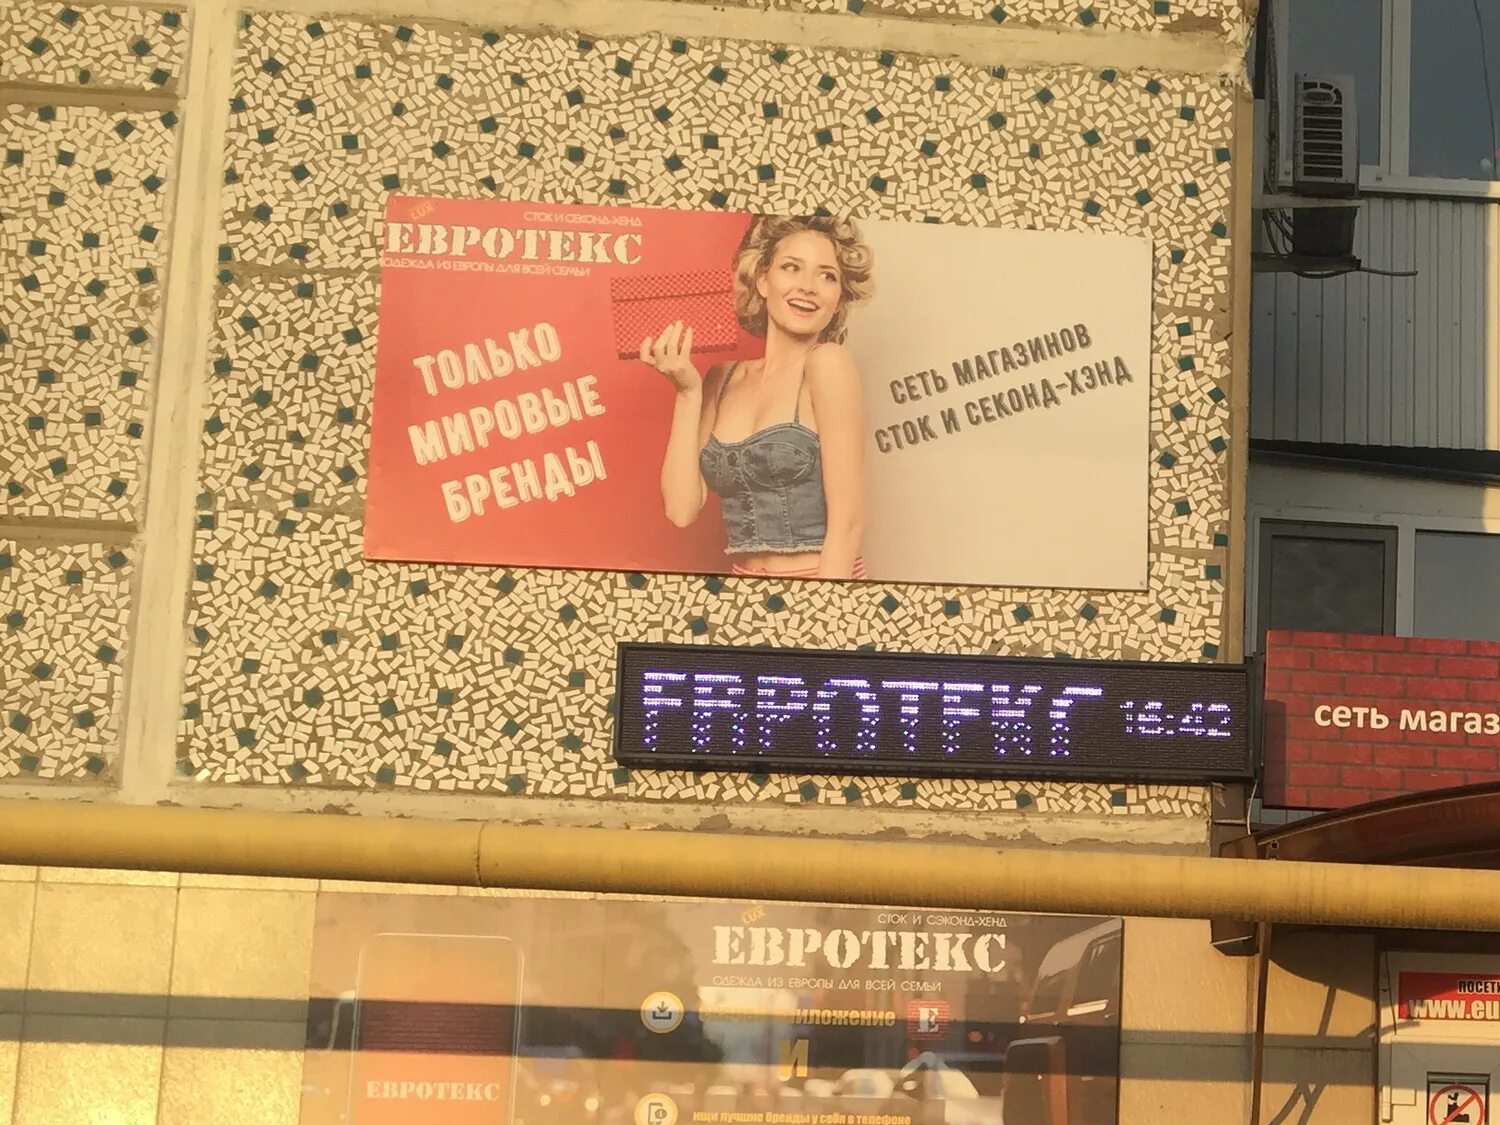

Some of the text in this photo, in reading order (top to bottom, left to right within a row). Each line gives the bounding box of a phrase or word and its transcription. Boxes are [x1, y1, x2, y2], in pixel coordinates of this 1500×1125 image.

[523, 211, 553, 223] СТОК
[554, 213, 565, 224] И
[384, 222, 643, 265] ЕВРОТЕКС
[382, 258, 591, 277] ОДЕЖДА ИЗ ЕВРОПЫ ДЛЯ ВСЕЙ СЕМЬИ
[413, 321, 562, 396] ТОЛЬКО
[889, 323, 1092, 404] СЕТЬ МАГАЗИНОВ
[874, 355, 1134, 454] СТОК И СЕКОНД-ХЭНД
[407, 374, 606, 466] МИРОВЫЕ
[440, 440, 608, 524] БРЕНДЫ
[1314, 704, 1389, 730] сеть
[741, 904, 767, 924] LUX
[877, 913, 908, 925] СТОК
[912, 914, 922, 925] И
[711, 925, 1007, 973] ЕВРОТЕКС
[712, 975, 942, 993] ОДЕЖДА ИЗ ЕВРОПЫ ДЛЯ ВСЕЙ СЕМЬИ
[782, 1007, 897, 1027] иложение
[366, 1080, 500, 1102] ЕВРОТЕКС
[692, 1111, 911, 1125] ищи лучшие бренды у себя в телефоне
